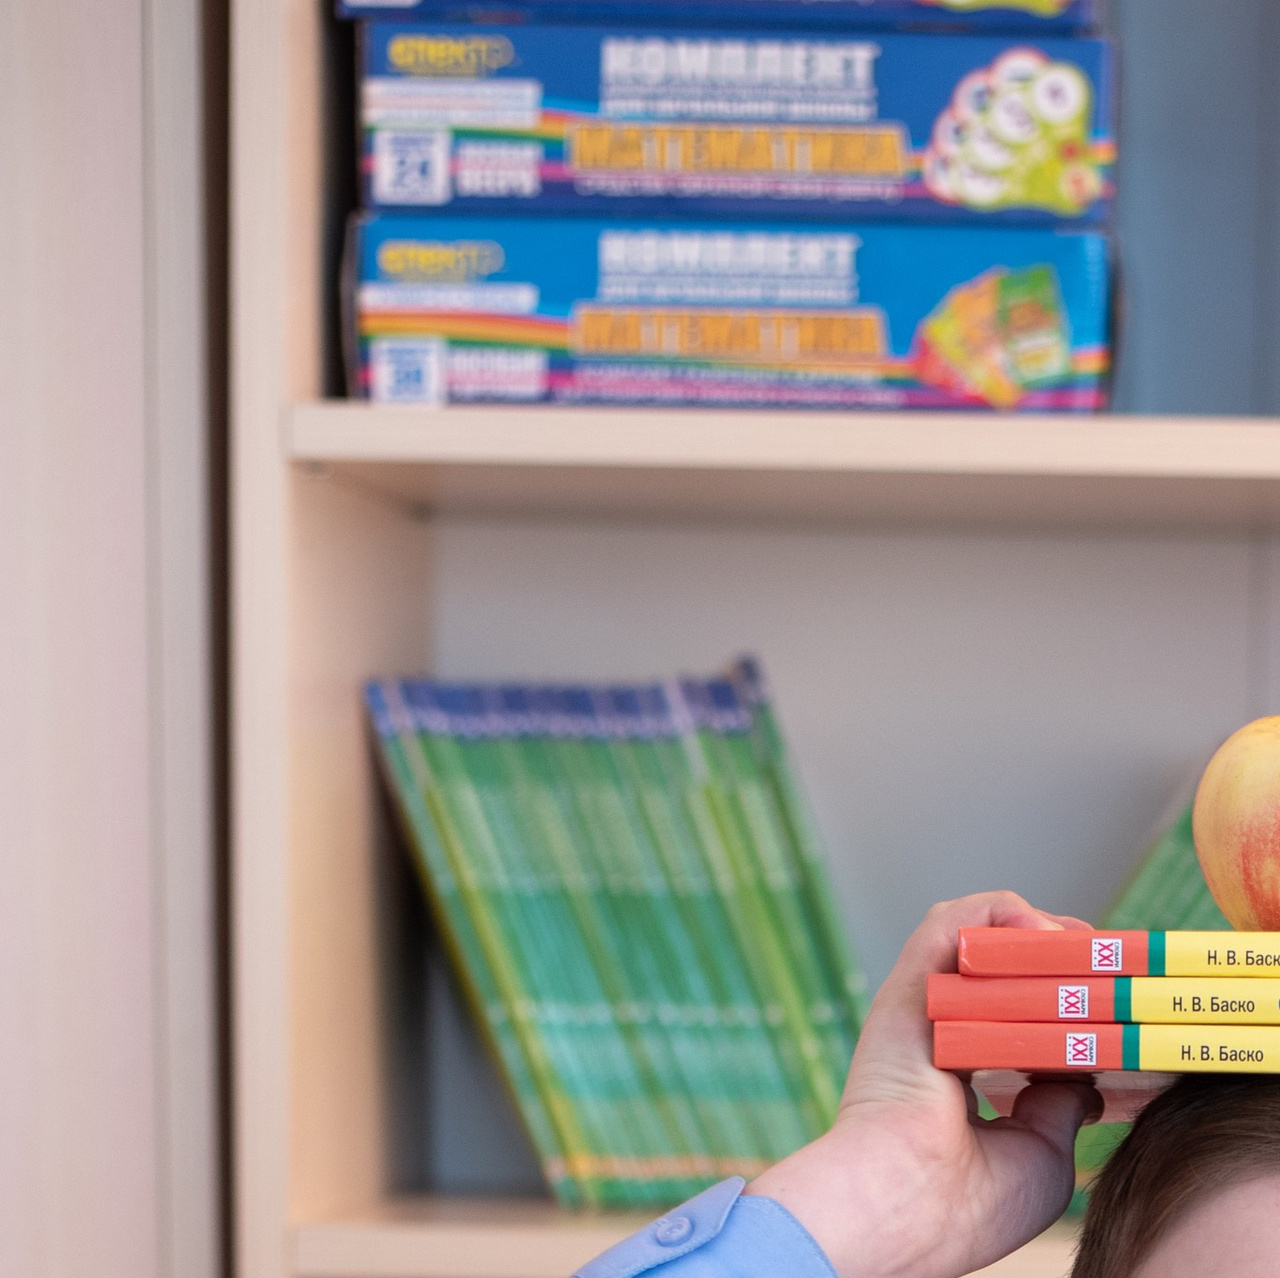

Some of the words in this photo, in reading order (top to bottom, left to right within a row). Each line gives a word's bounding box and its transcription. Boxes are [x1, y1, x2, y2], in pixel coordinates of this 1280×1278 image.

[1098, 941, 1114, 968] XXI
[1207, 950, 1222, 966] Н.
[1227, 950, 1241, 966] В.
[1064, 988, 1081, 1015] XXI
[1172, 996, 1187, 1012] Н.
[1192, 997, 1206, 1012] В.
[1210, 997, 1255, 1013] Баско
[1072, 1036, 1088, 1062] XXI
[1181, 1045, 1196, 1061] Н.
[1201, 1046, 1214, 1061] В.
[1219, 1045, 1264, 1062] Баско
